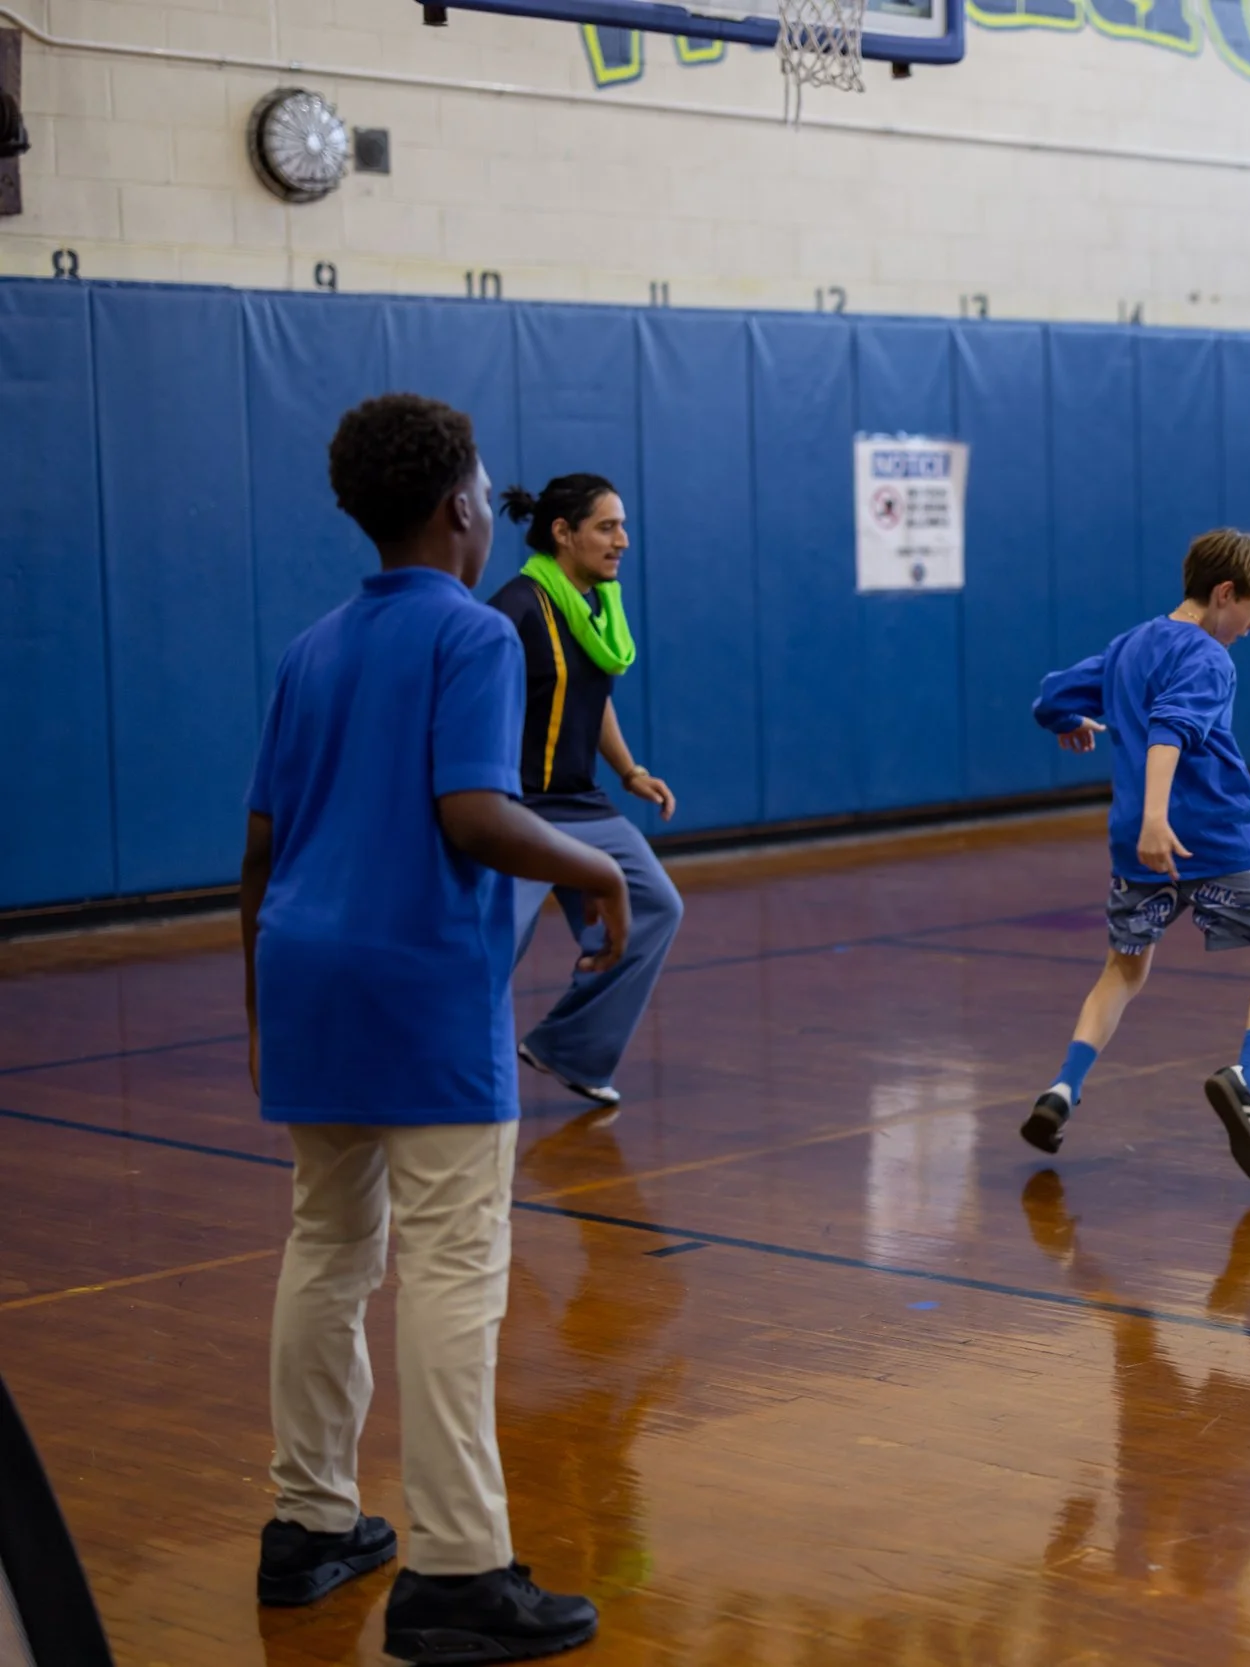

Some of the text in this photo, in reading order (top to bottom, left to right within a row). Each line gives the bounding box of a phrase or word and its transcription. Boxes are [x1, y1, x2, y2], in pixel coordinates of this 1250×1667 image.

[52, 249, 79, 278] 8
[314, 262, 337, 292] 9
[465, 270, 502, 299] 10
[650, 281, 670, 307] 11
[1199, 883, 1238, 906] NIKE
